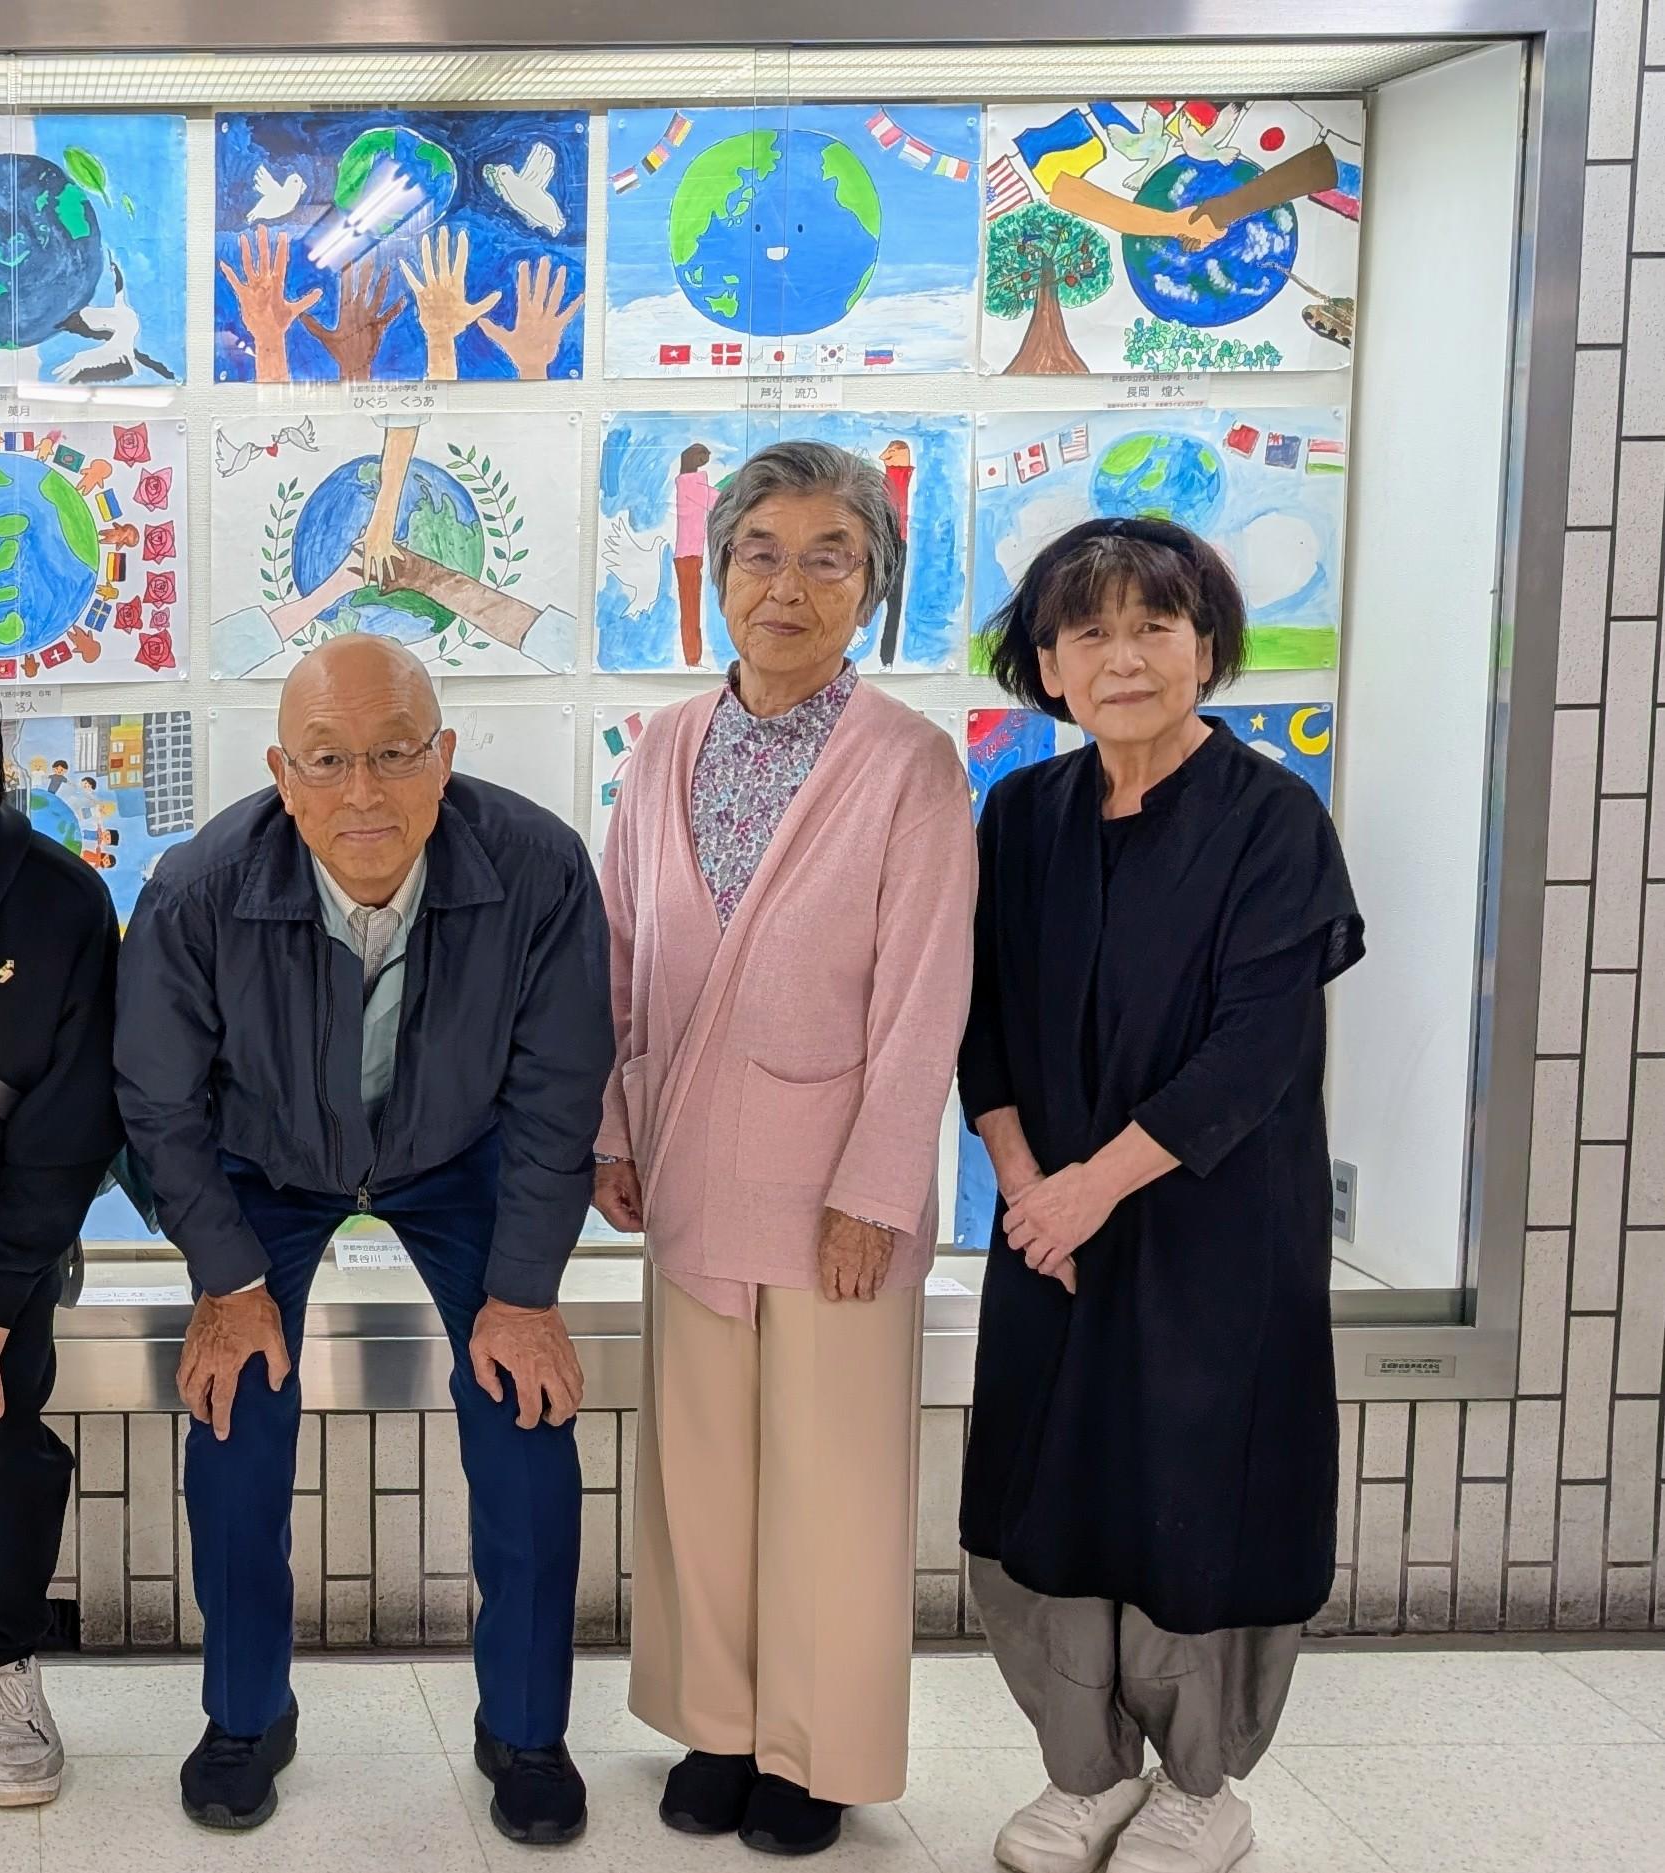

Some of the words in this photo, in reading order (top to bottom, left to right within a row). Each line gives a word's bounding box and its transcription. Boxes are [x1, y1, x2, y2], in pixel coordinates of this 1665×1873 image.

[1126, 386, 1150, 398] 長岡
[353, 396, 388, 409] ひぐち
